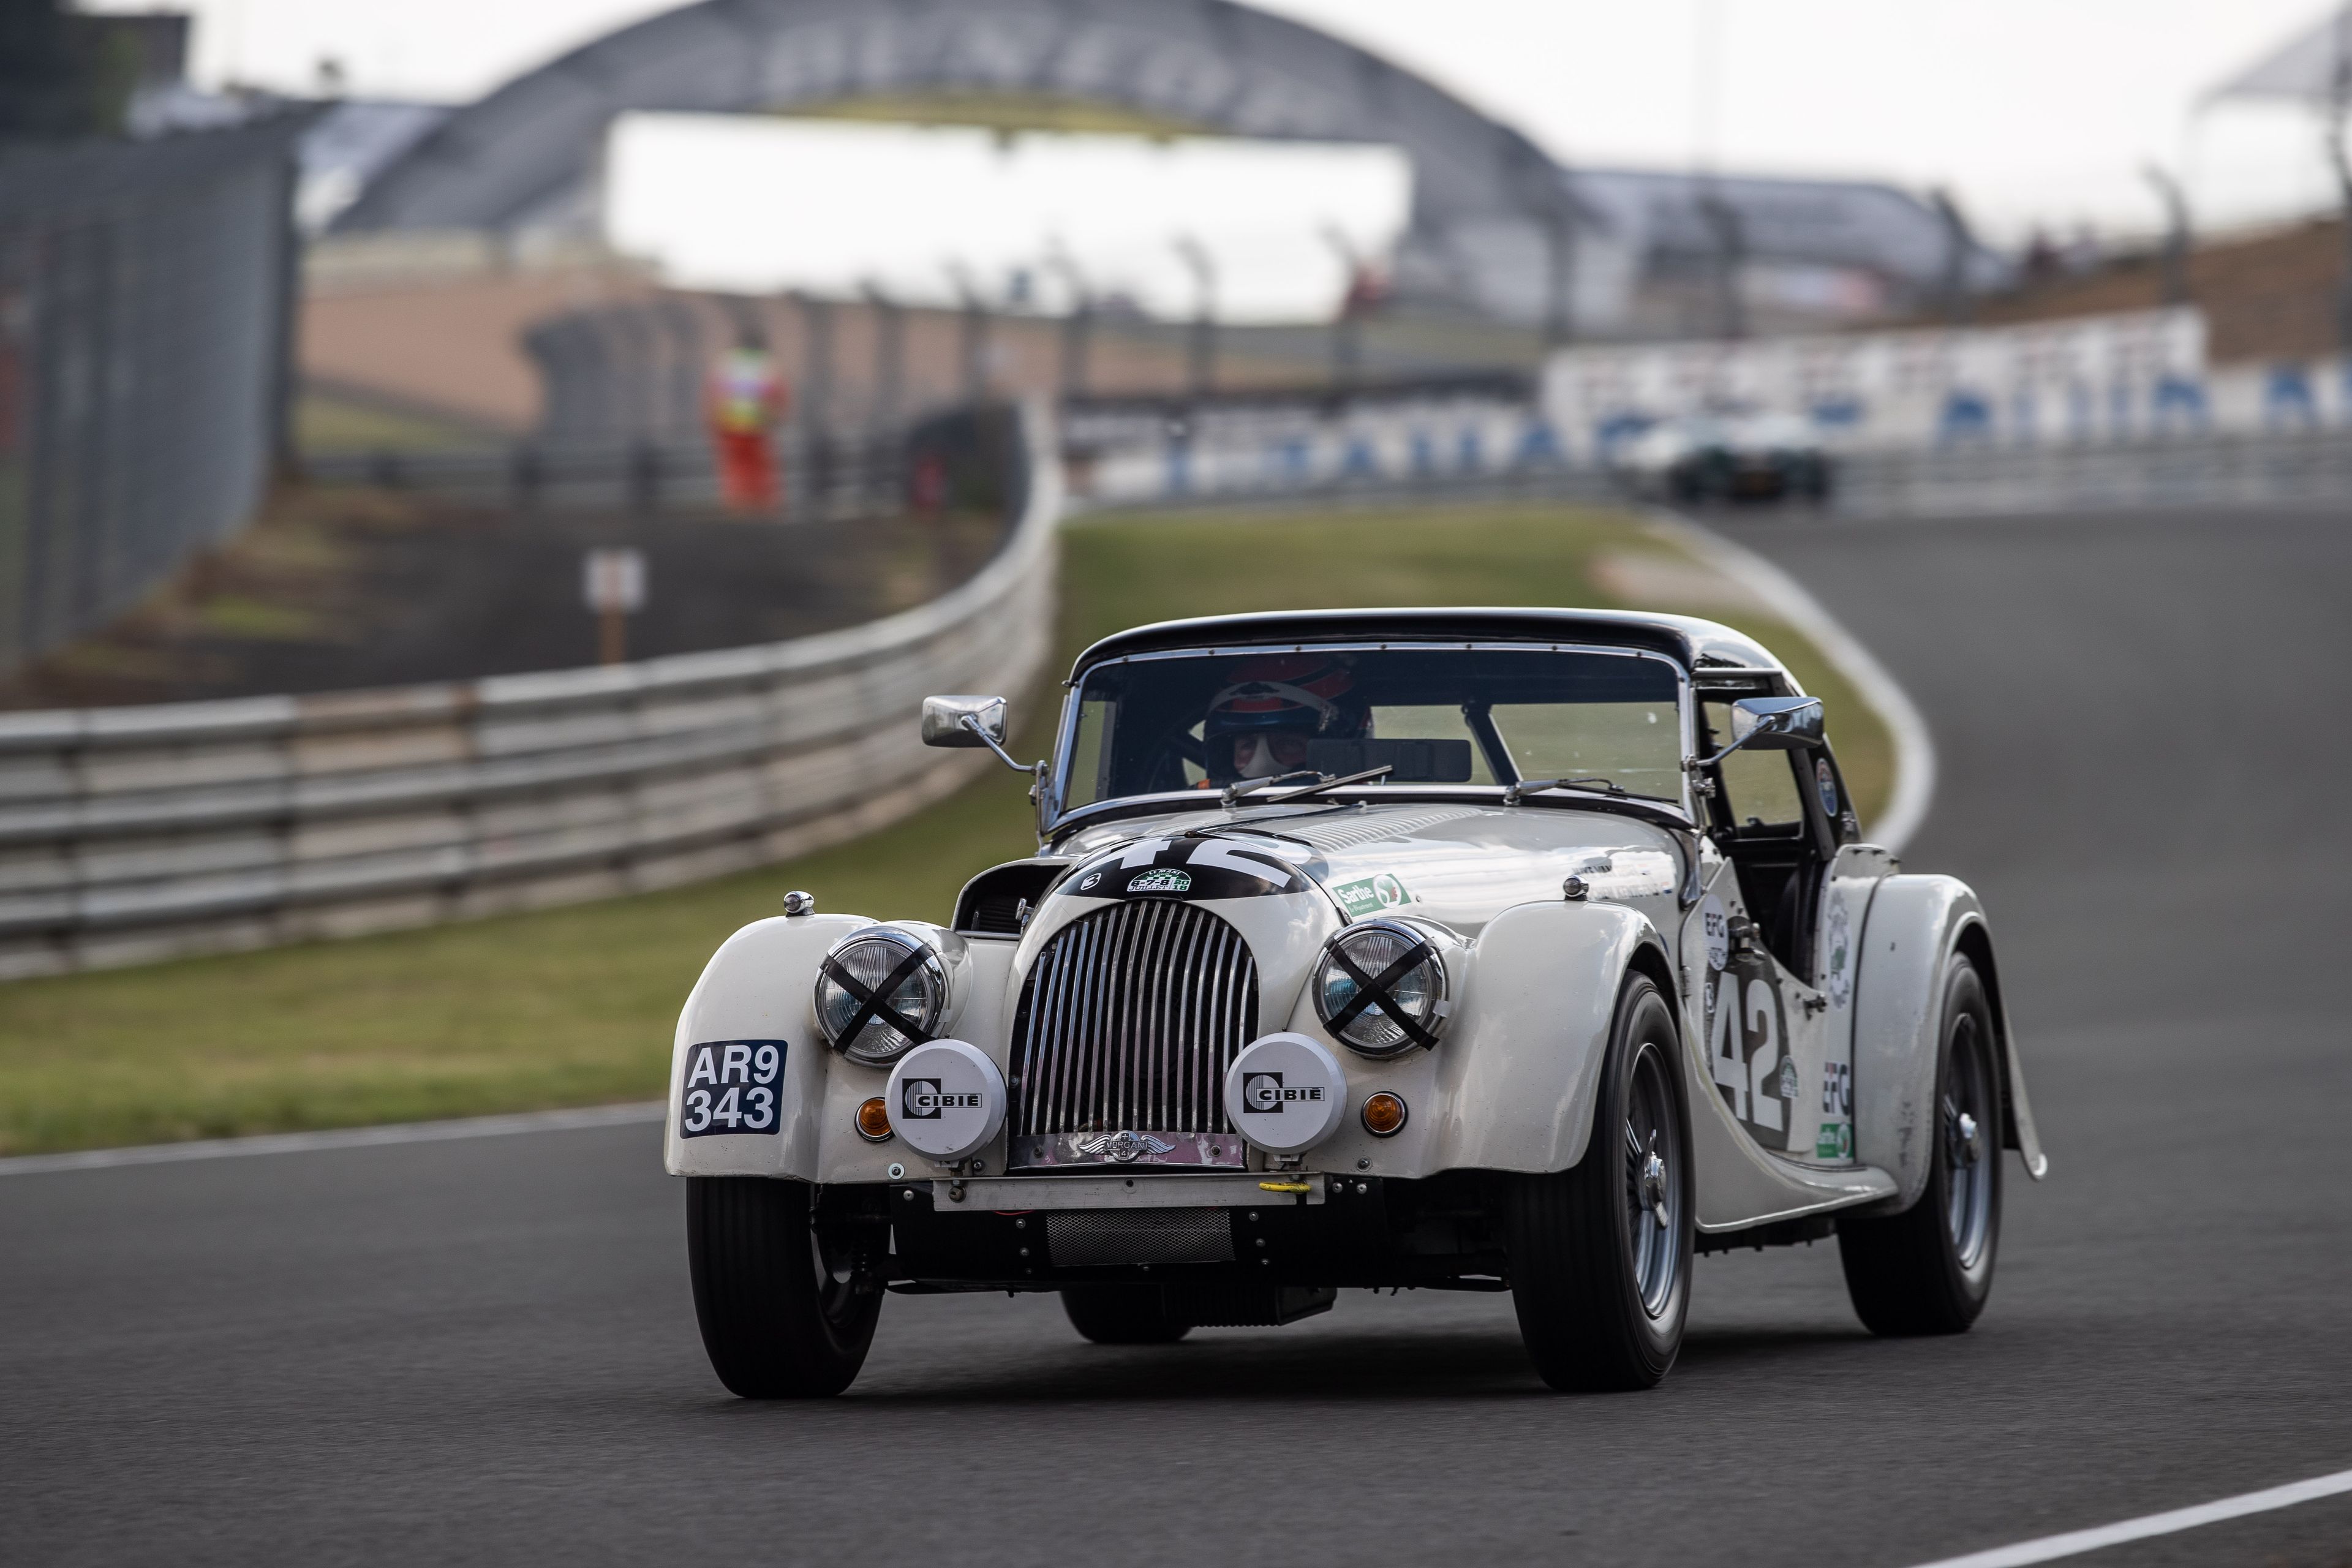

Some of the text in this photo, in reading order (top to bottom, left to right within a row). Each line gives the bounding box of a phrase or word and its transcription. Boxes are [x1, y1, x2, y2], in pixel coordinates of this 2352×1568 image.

[1337, 884, 1374, 904] Sarthe
[687, 1044, 779, 1088] AR9
[1711, 971, 1784, 1132] 42
[685, 1087, 774, 1132] 343
